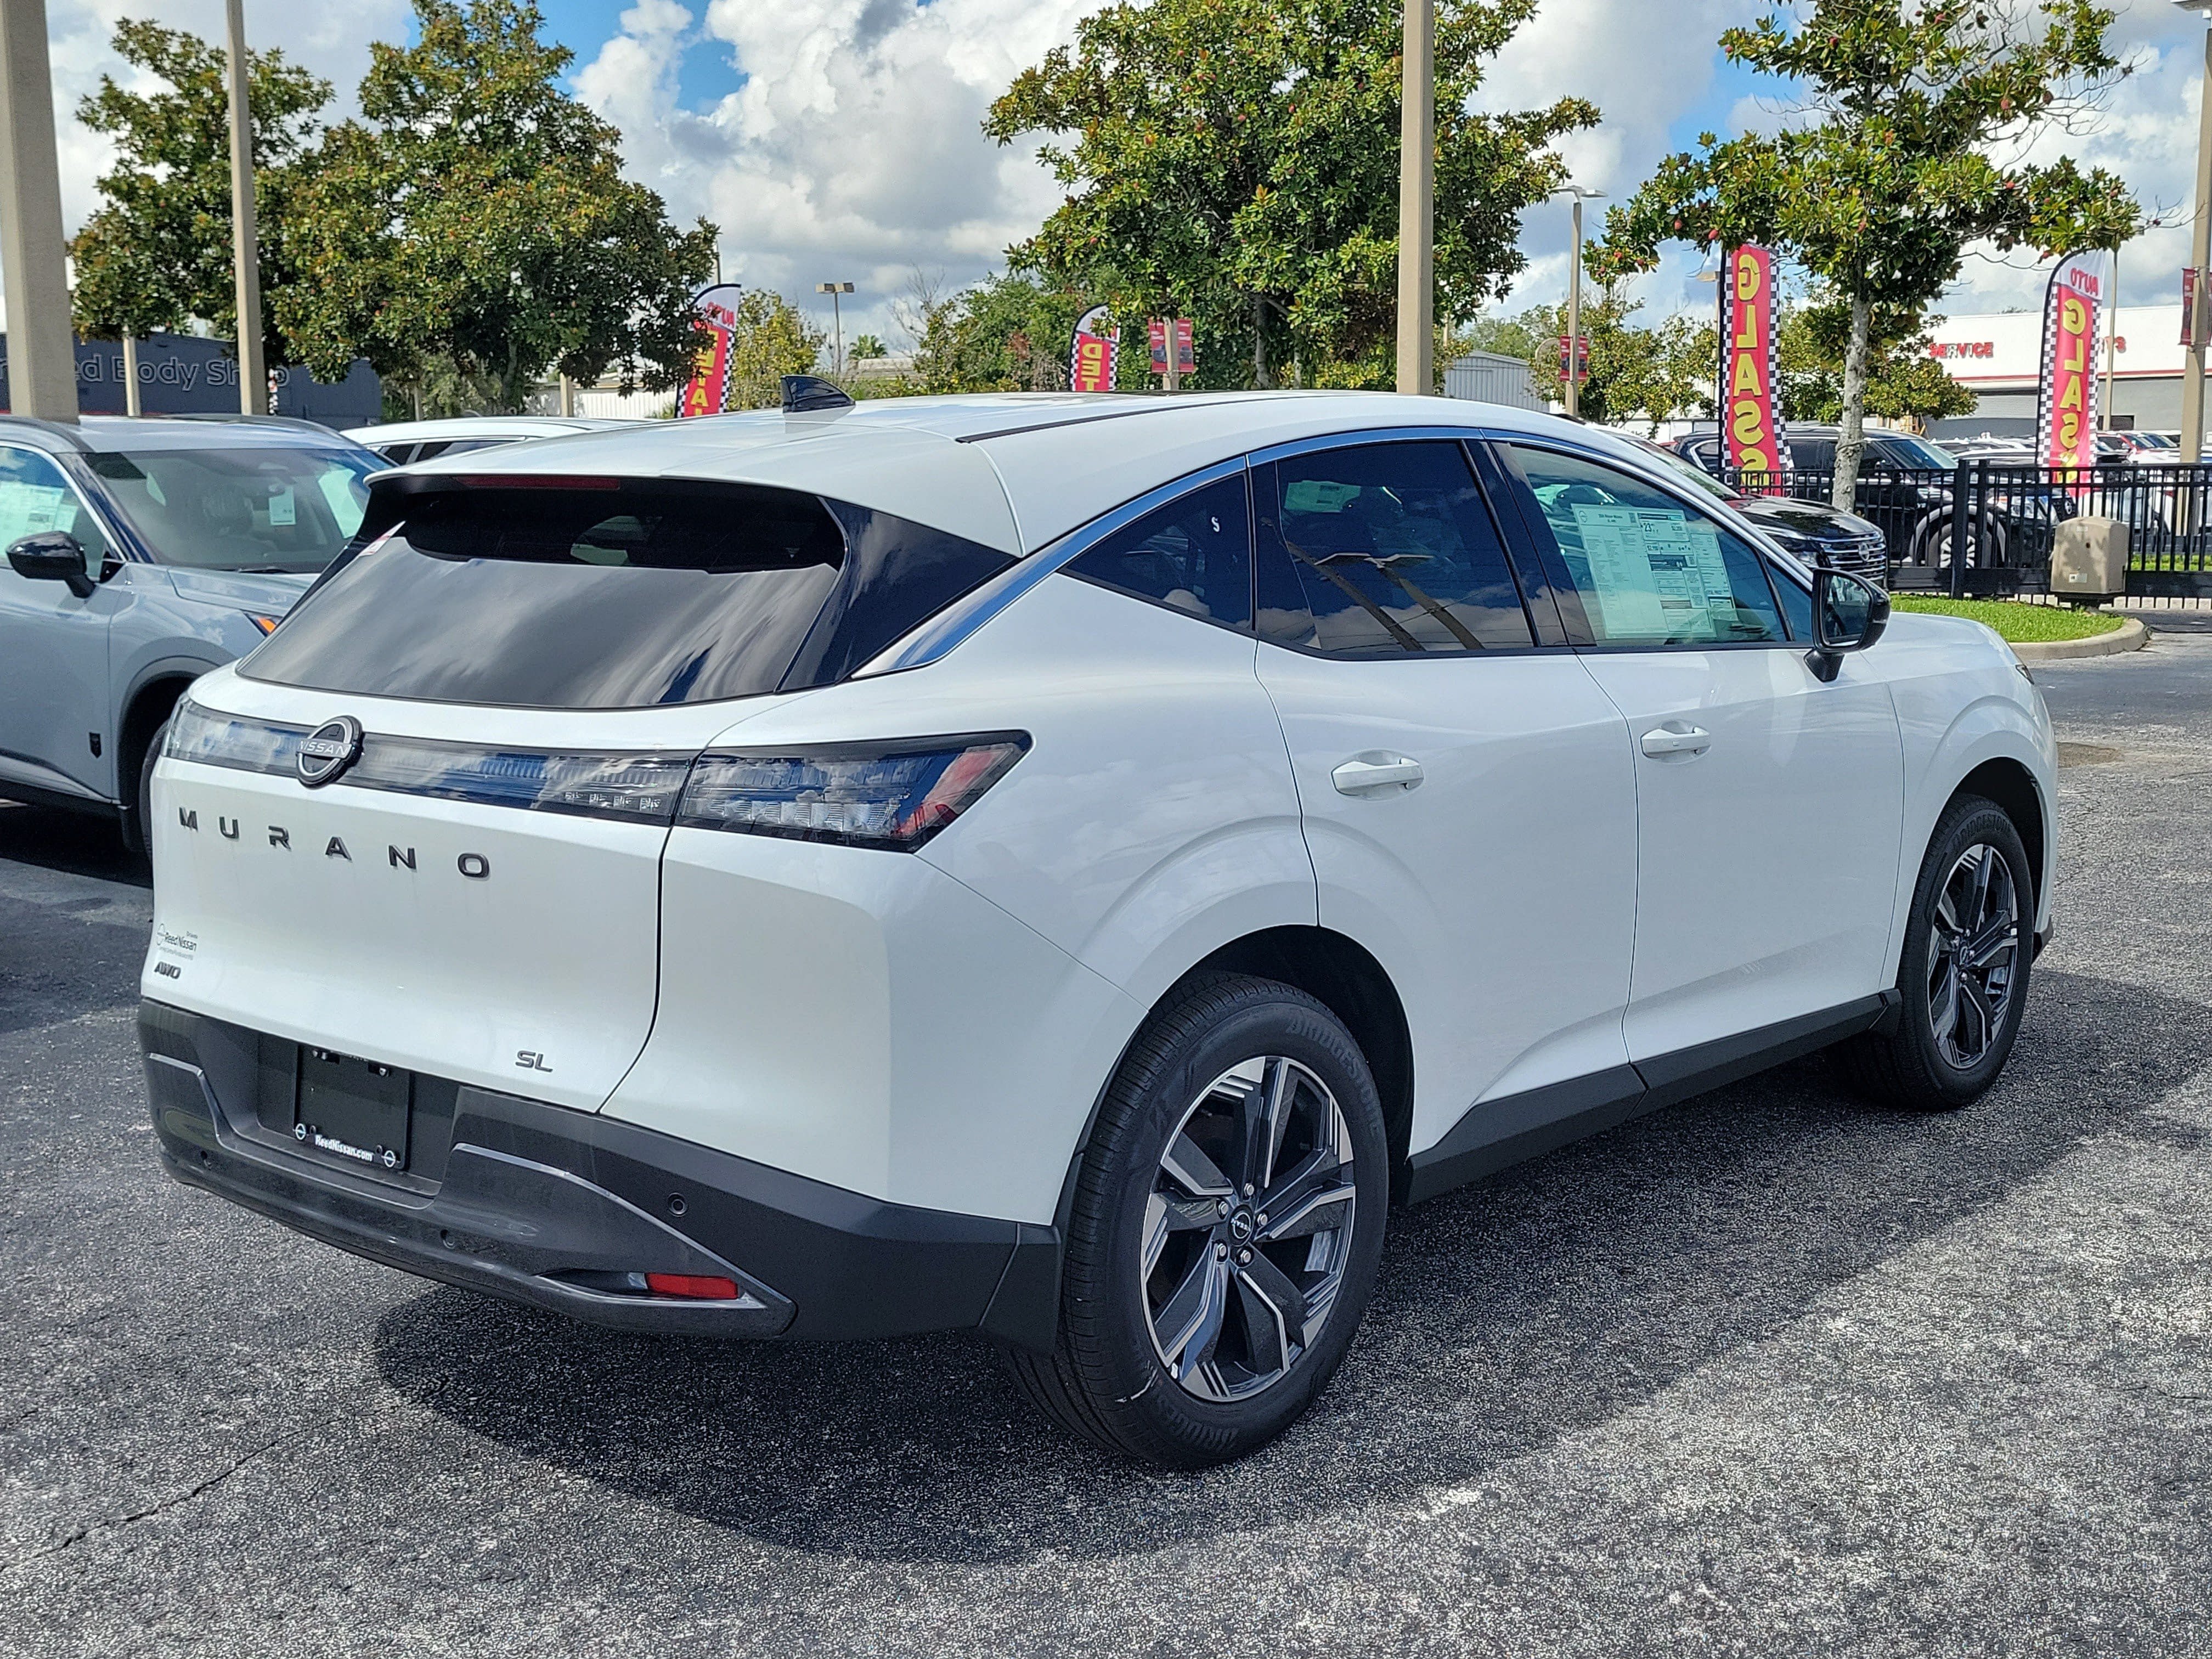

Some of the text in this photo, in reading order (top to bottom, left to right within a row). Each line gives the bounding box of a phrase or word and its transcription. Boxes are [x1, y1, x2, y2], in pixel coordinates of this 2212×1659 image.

[298, 741, 348, 756] NISSAN
[179, 806, 490, 878] MURANO
[154, 961, 181, 979] AWD
[515, 1050, 553, 1073] SL
[314, 1133, 374, 1162] ReedNissan.com
